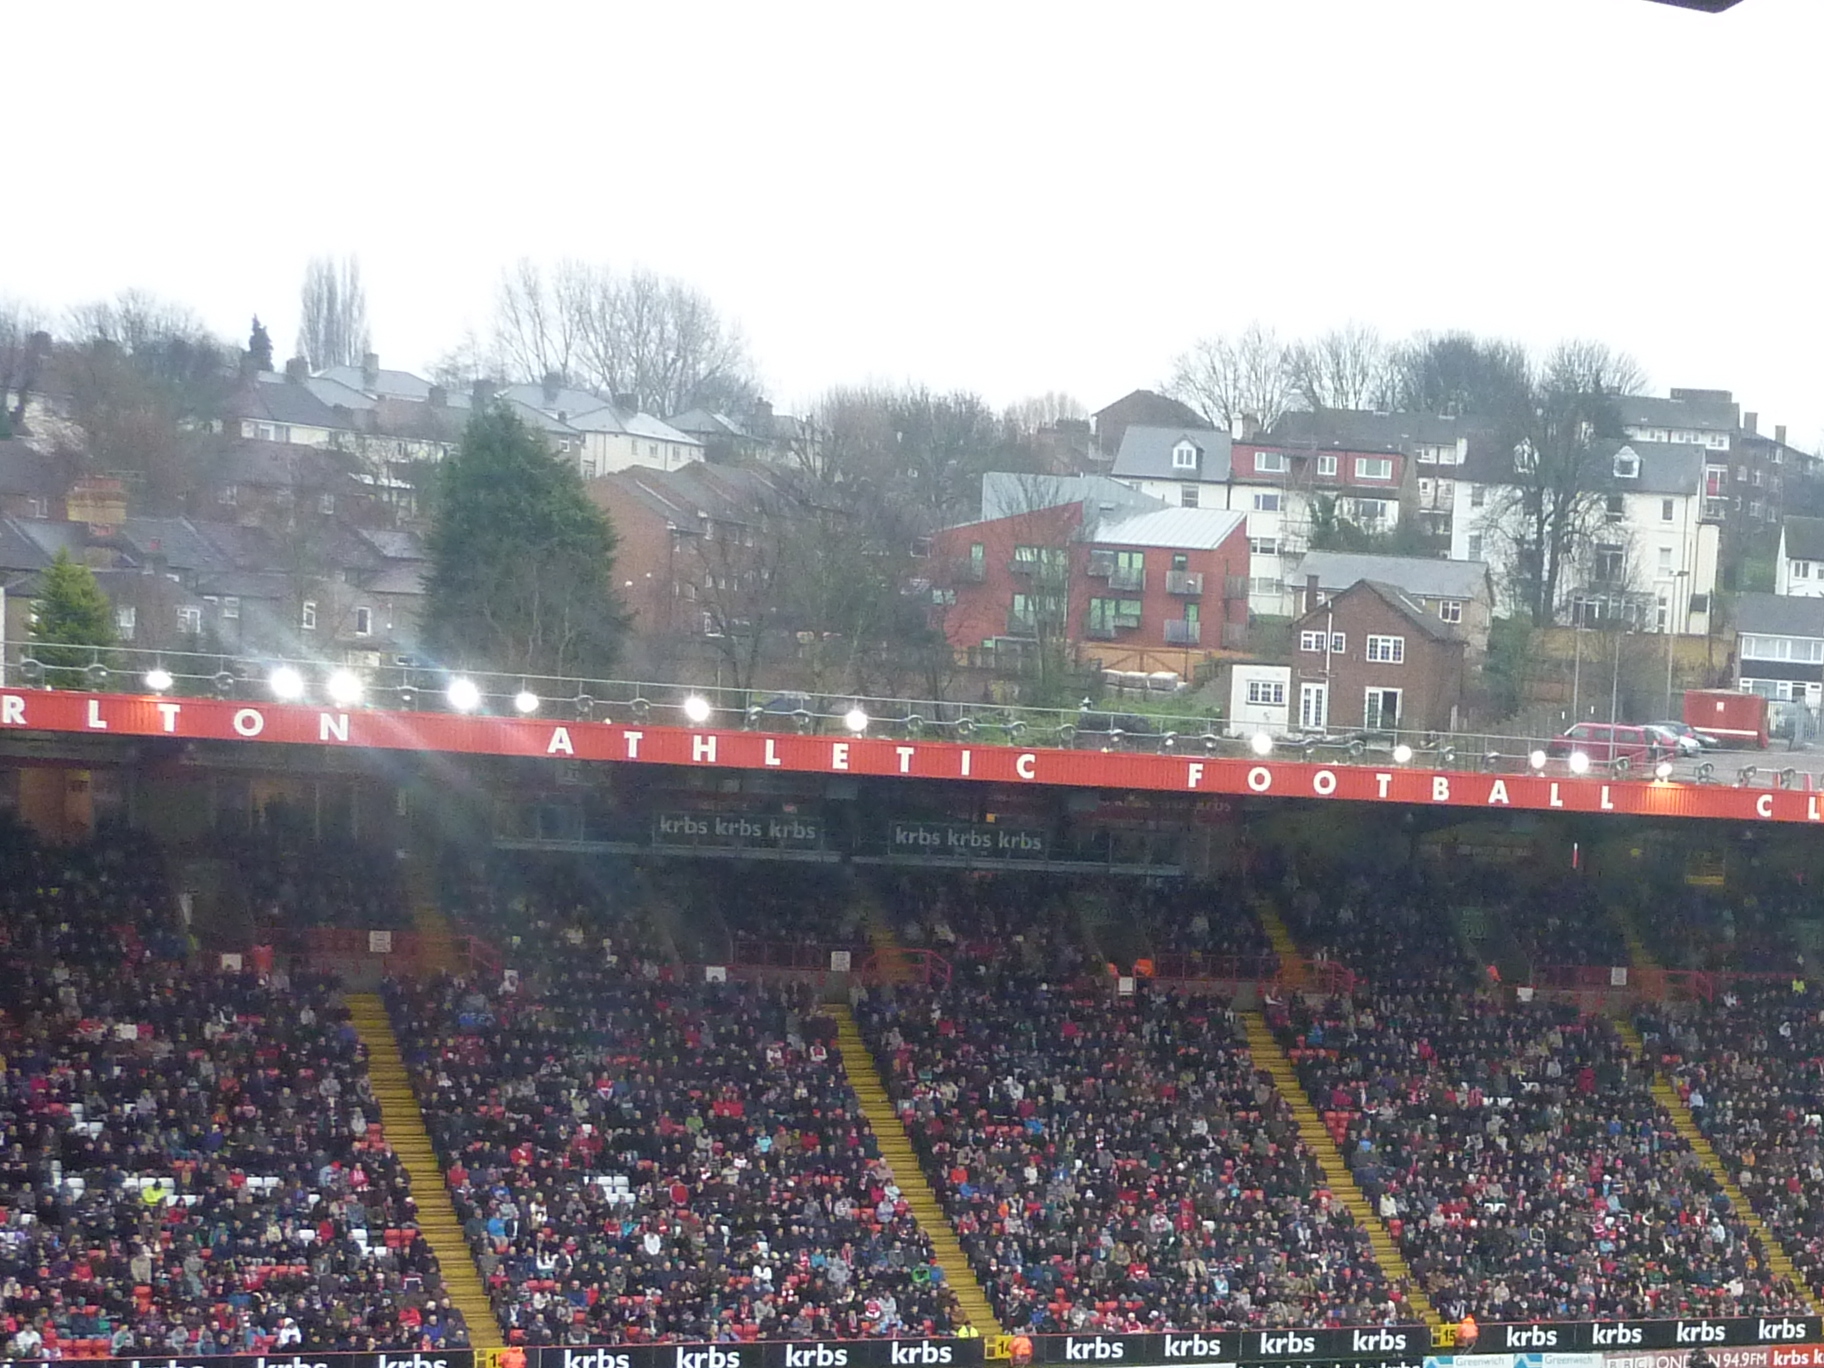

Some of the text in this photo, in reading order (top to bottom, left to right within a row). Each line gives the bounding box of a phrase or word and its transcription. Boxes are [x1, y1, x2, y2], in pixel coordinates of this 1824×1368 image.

[547, 726, 1036, 780] ATHLETIC
[1187, 762, 1614, 810] FOOTBALL
[660, 814, 816, 840] krbs krbs krbs
[895, 826, 1042, 851] krbs krbs krbs
[1065, 1329, 1407, 1360] krbs krbs krbs krbs
[1506, 1318, 1806, 1348] krbs krbs krbs krbs
[785, 1343, 849, 1368] krbs
[891, 1341, 952, 1365] krbs
[1456, 1357, 1504, 1367] Greenwich
[1545, 1355, 1592, 1365] Greenwich
[1773, 1348, 1809, 1366] krbs
